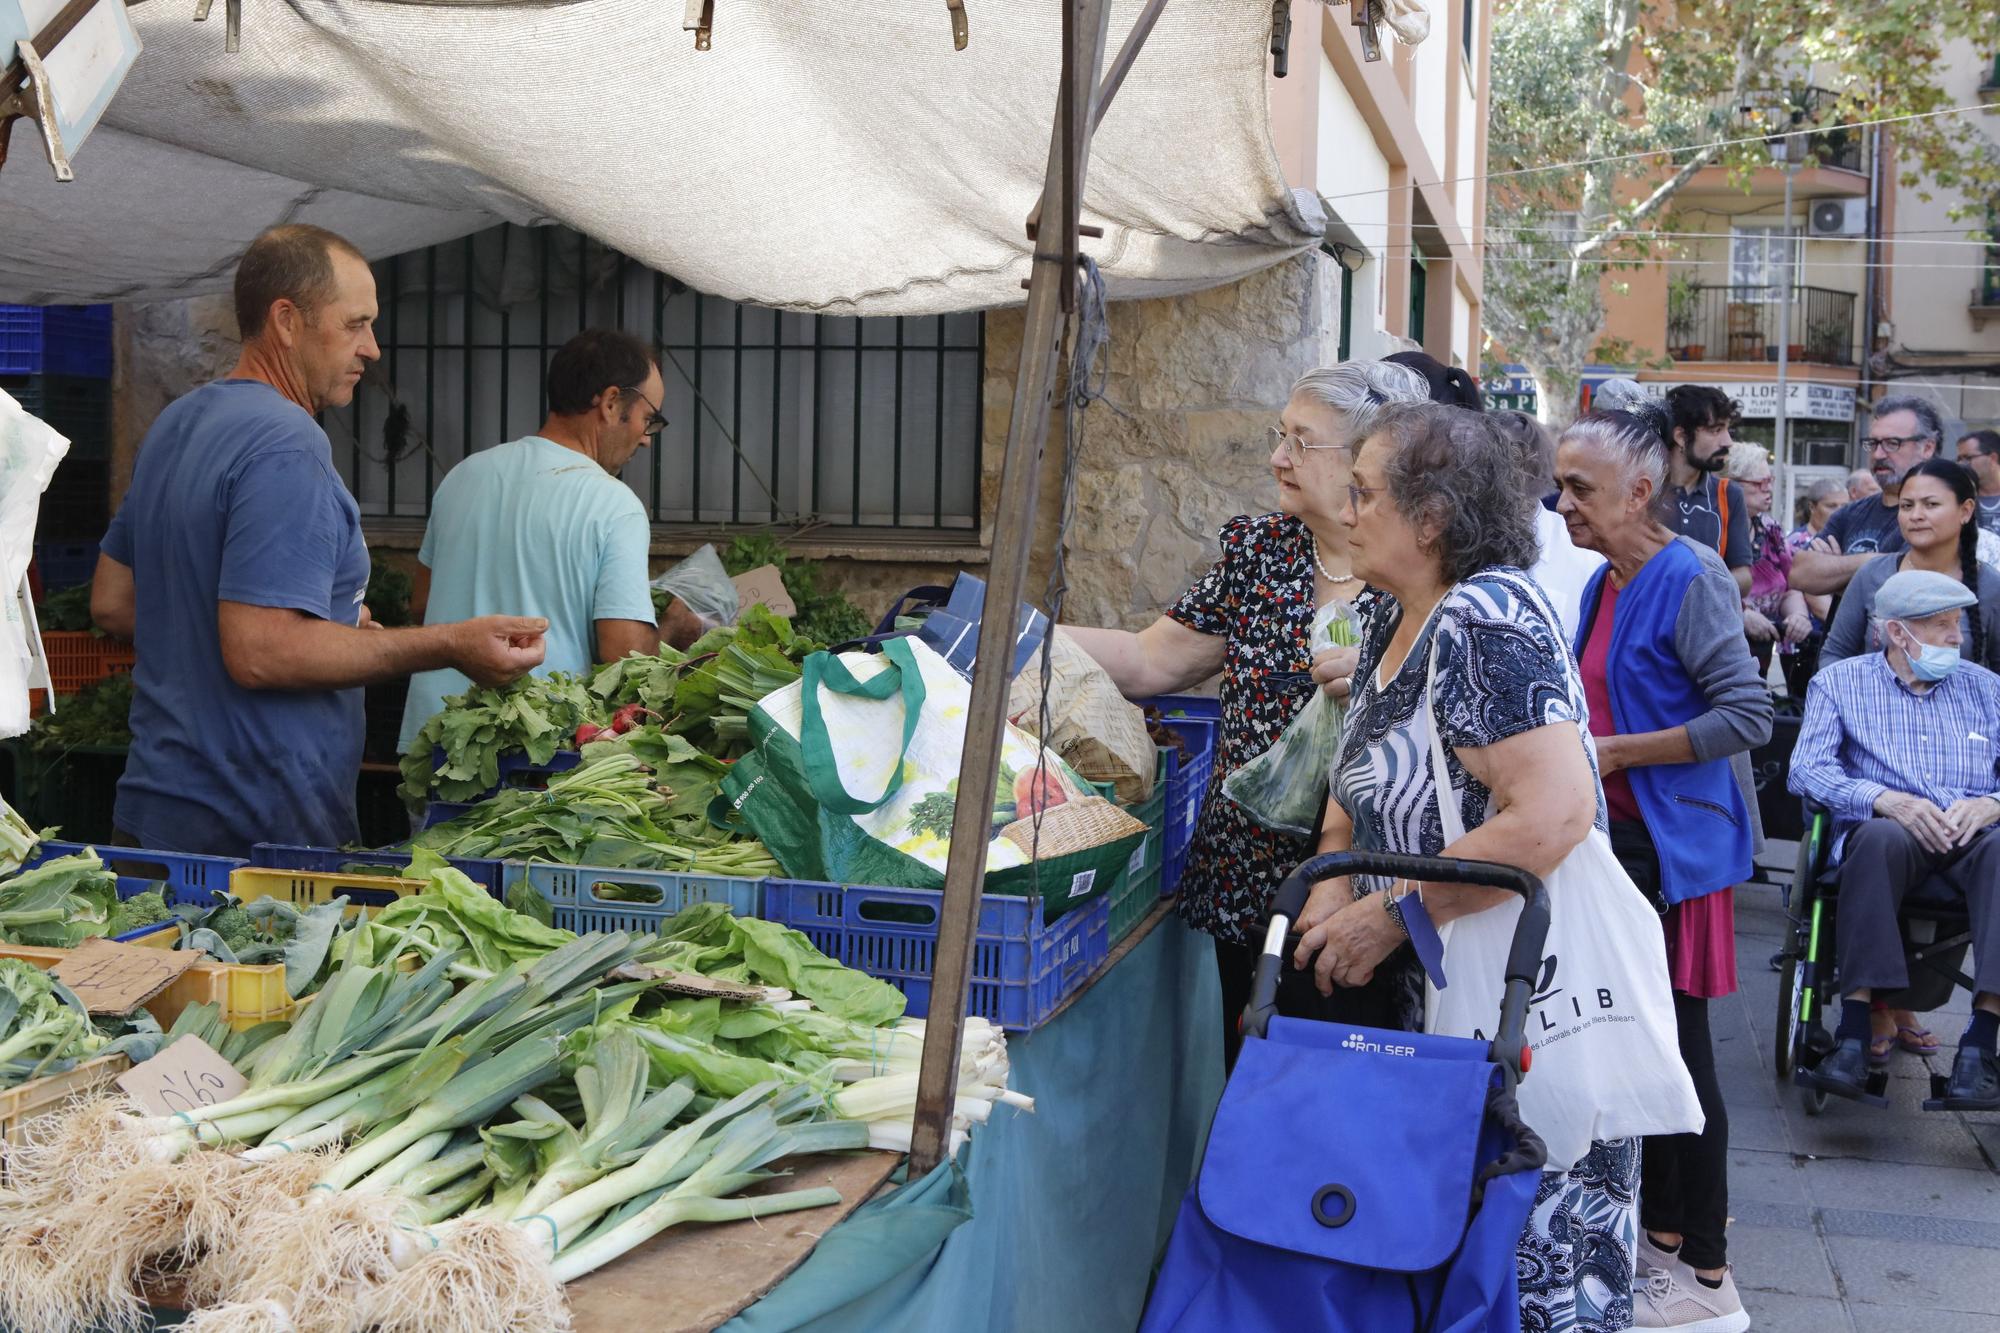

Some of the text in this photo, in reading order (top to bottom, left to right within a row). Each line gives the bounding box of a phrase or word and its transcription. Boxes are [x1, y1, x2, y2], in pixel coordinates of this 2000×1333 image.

[1484, 394, 1509, 410] Sa
[1540, 1027, 1571, 1047] Laborals
[1571, 1025, 1582, 1034] de
[1607, 1014, 1636, 1023] Balears
[1355, 1042, 1415, 1057] ROLSER
